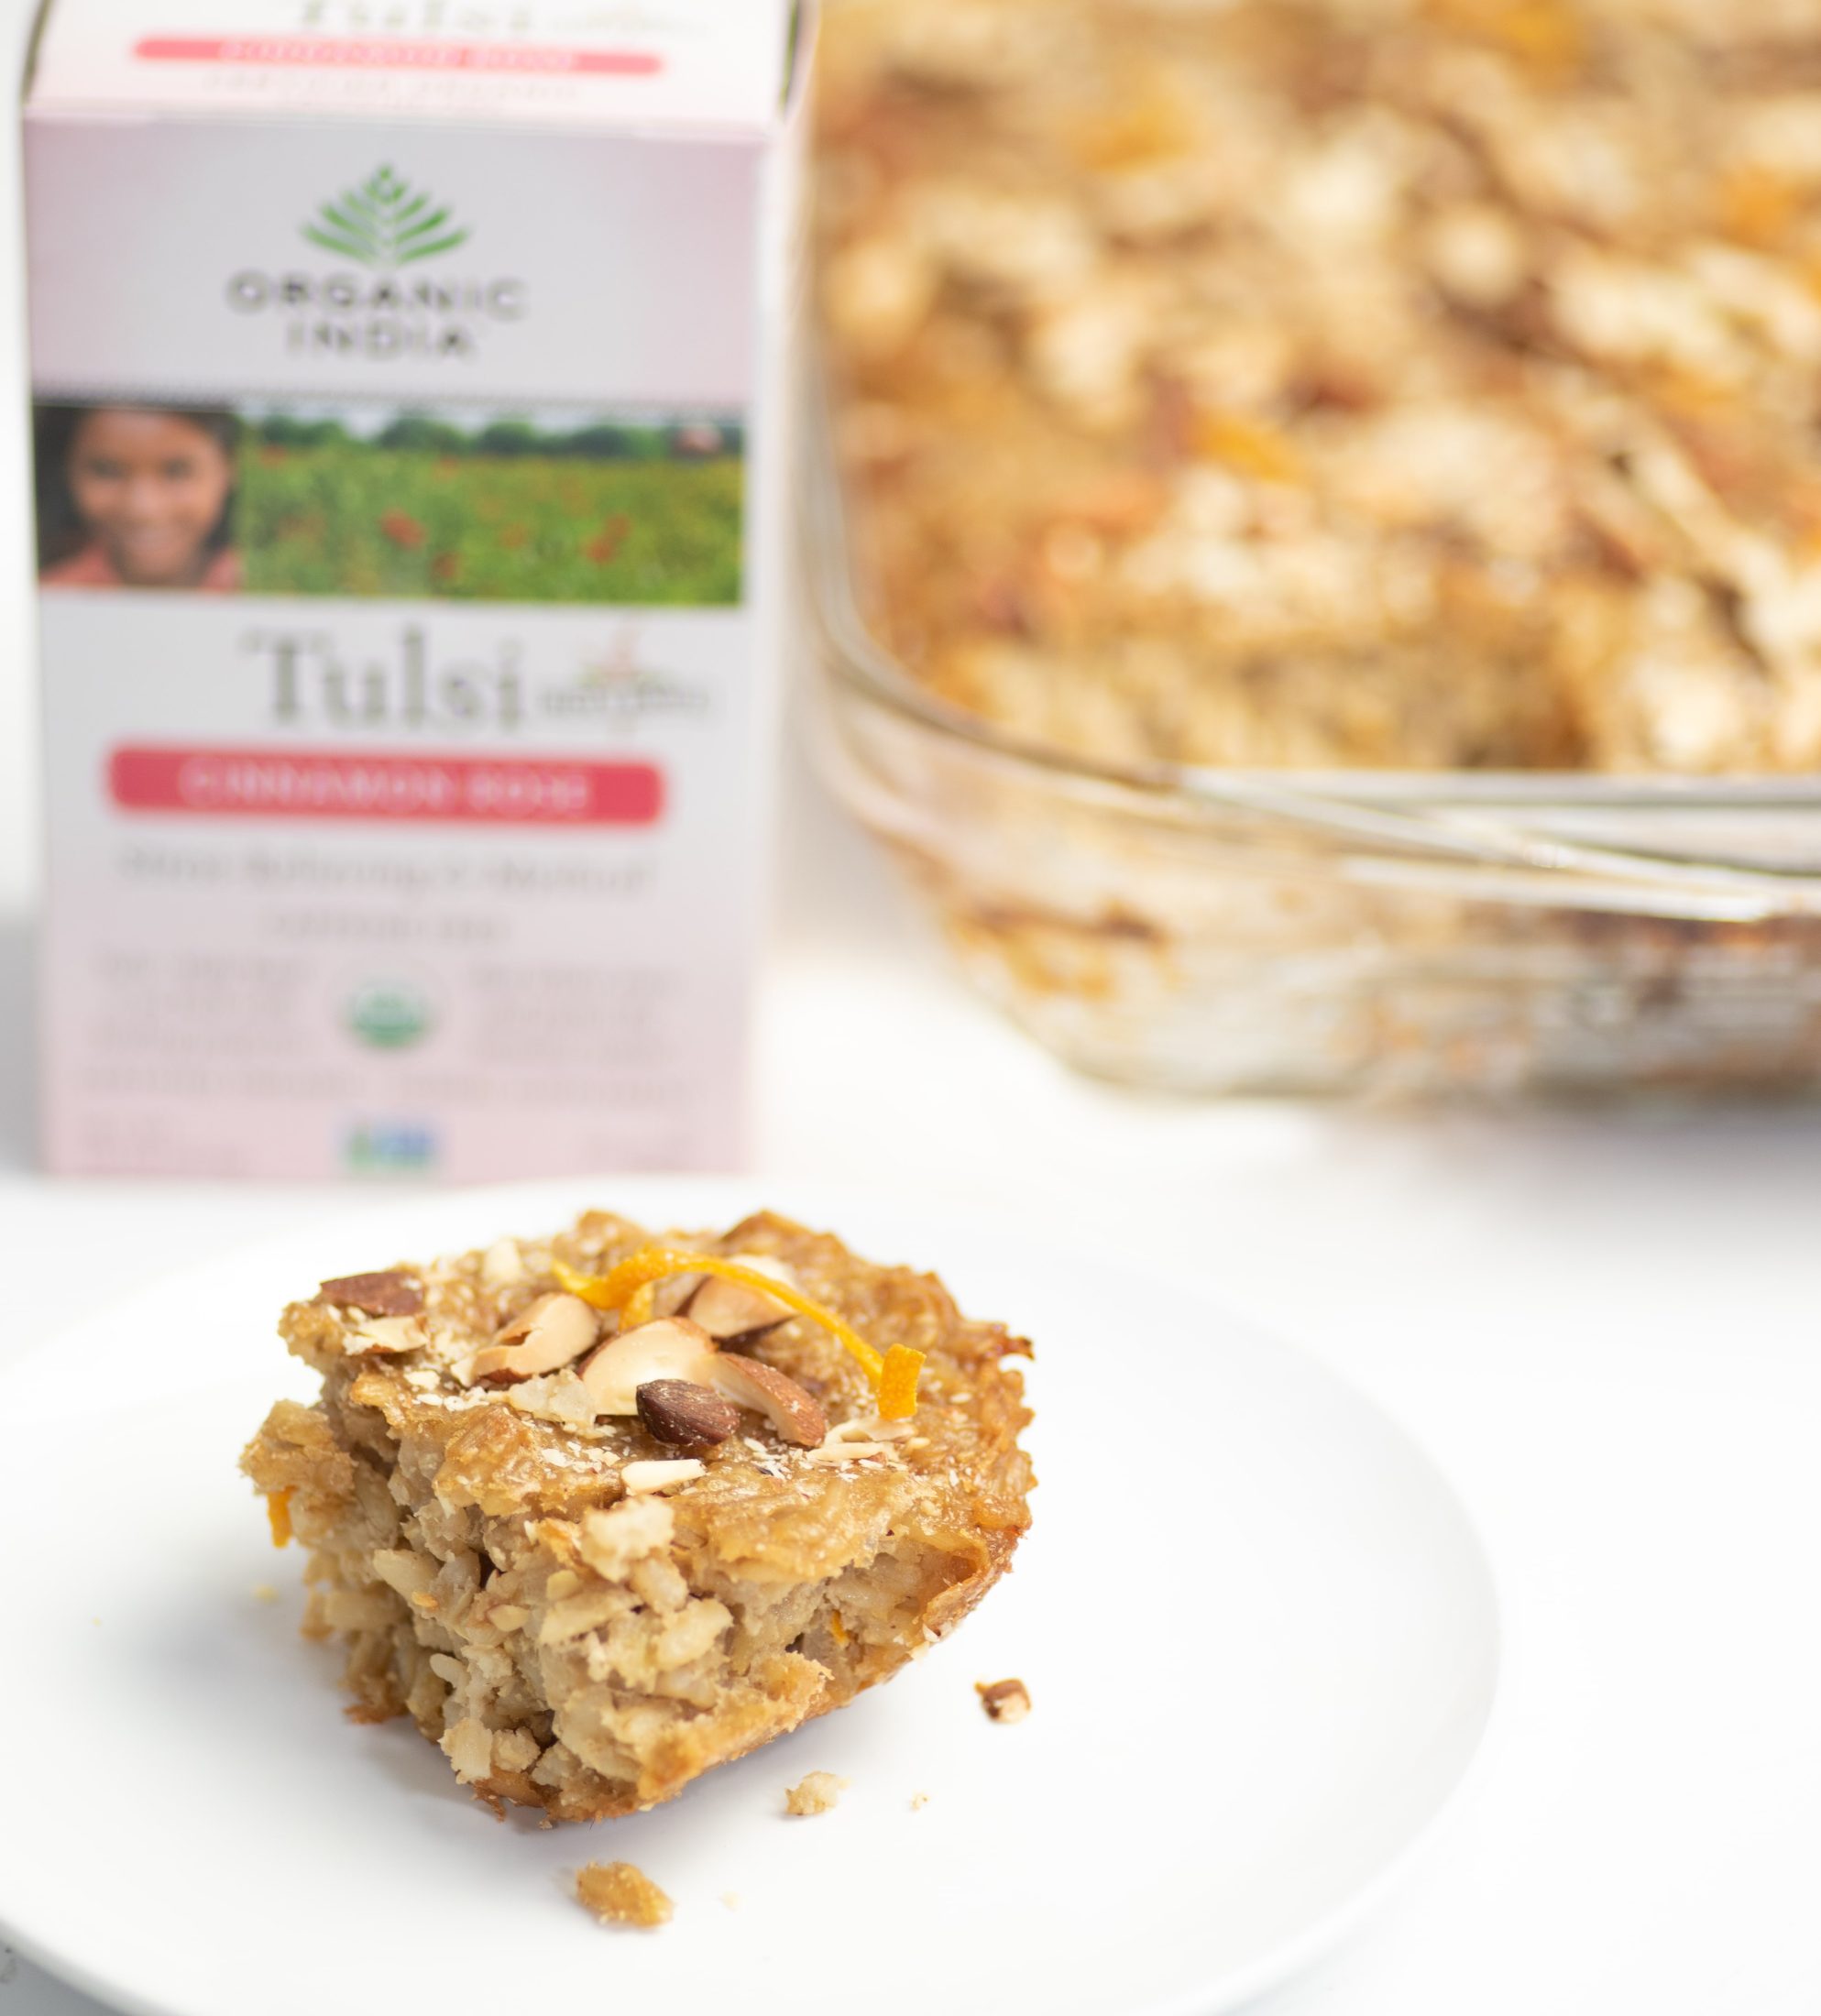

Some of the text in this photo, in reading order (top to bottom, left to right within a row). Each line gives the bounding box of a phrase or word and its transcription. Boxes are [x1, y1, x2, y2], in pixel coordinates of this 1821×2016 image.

[226, 270, 529, 320] ORGANIC
[286, 320, 478, 360] INDIA
[240, 626, 528, 733] Tulsi
[181, 757, 594, 816] CINNAMON ROSE
